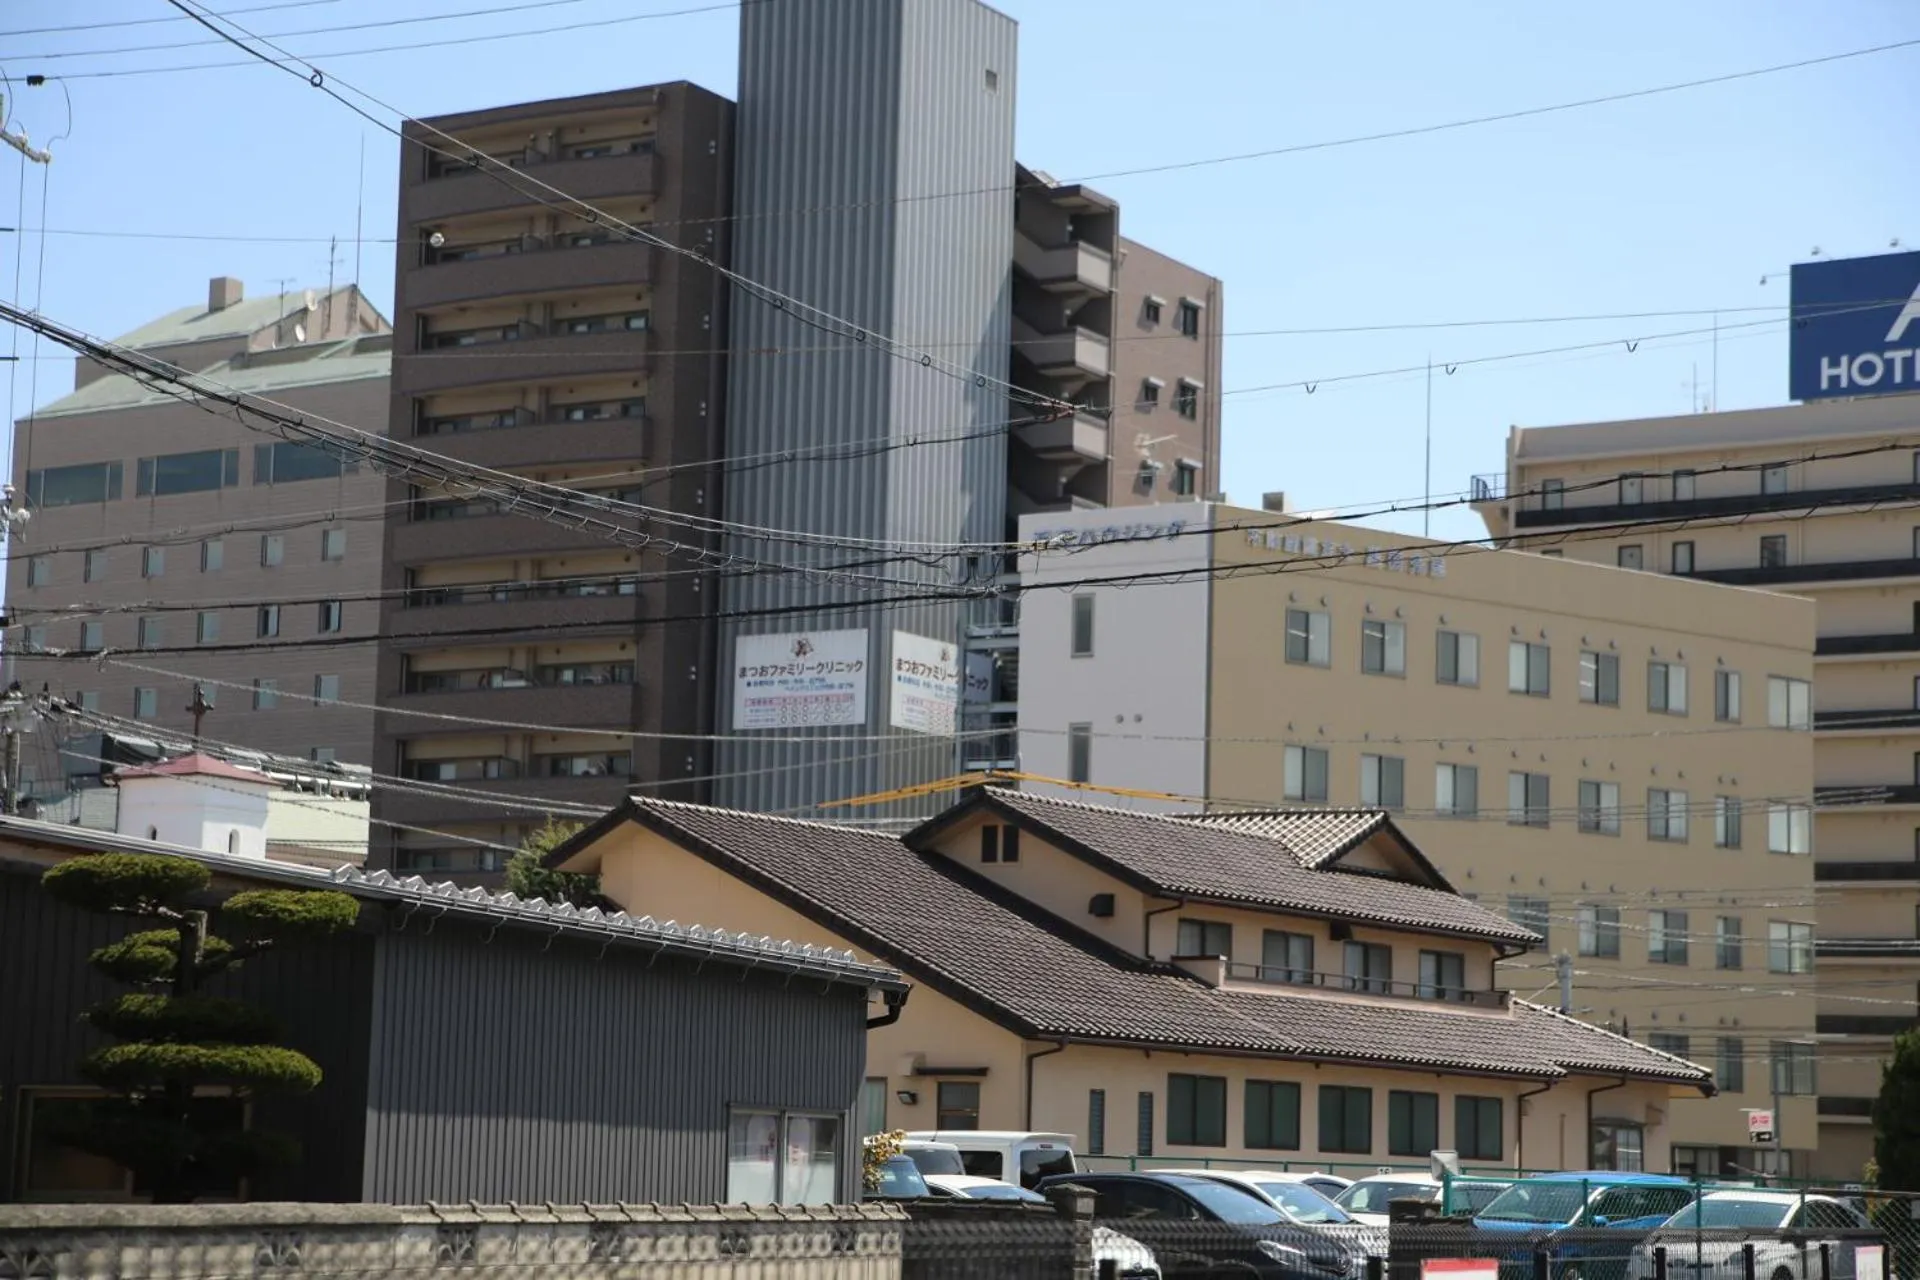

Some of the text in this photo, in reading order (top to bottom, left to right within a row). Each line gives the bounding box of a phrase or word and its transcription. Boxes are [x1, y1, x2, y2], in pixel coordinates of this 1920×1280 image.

[1820, 348, 1920, 391] HOT
[738, 659, 864, 679] まつおファミリークリニック
